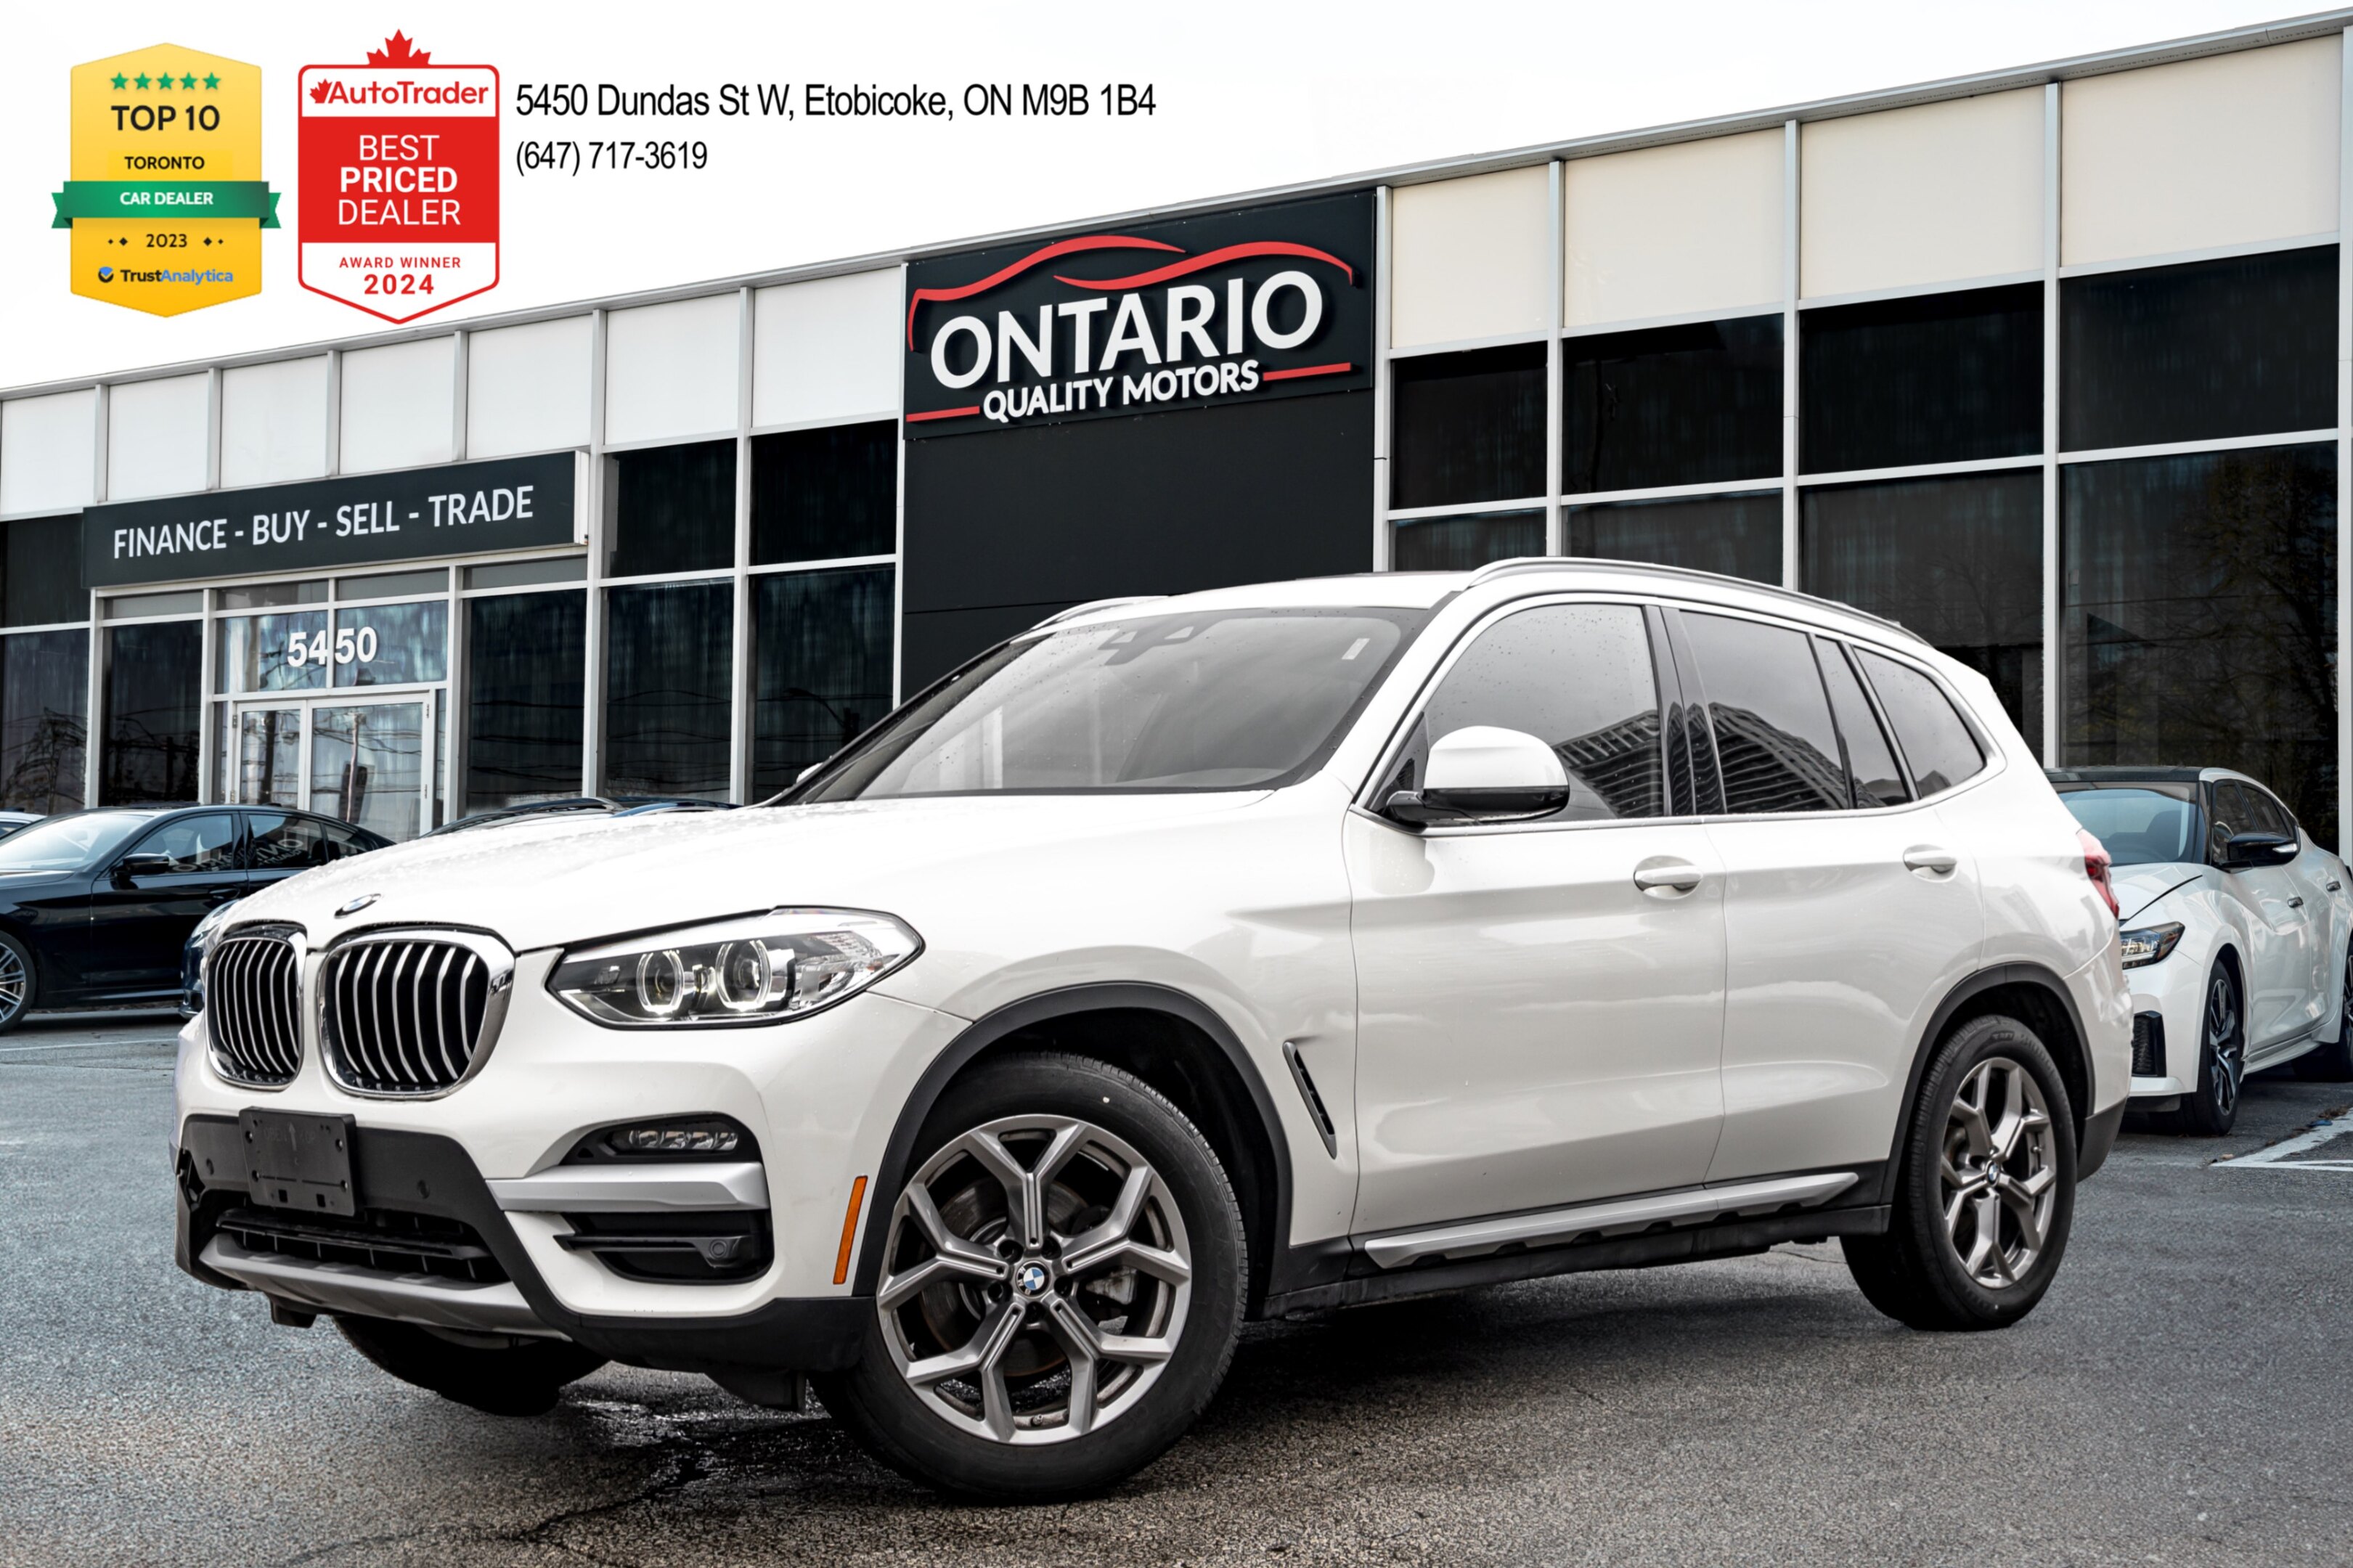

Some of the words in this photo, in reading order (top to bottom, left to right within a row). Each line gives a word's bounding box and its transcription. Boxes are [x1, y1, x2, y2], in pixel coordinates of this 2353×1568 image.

[931, 271, 1322, 389] ONTARIO
[983, 375, 1114, 423] QUALITY
[1122, 359, 1260, 405] MOTORS
[114, 518, 227, 559] FINANCE
[253, 510, 311, 545] BUY
[335, 500, 400, 537] SELL
[428, 485, 534, 527] TRADE
[287, 626, 378, 668] 5450
